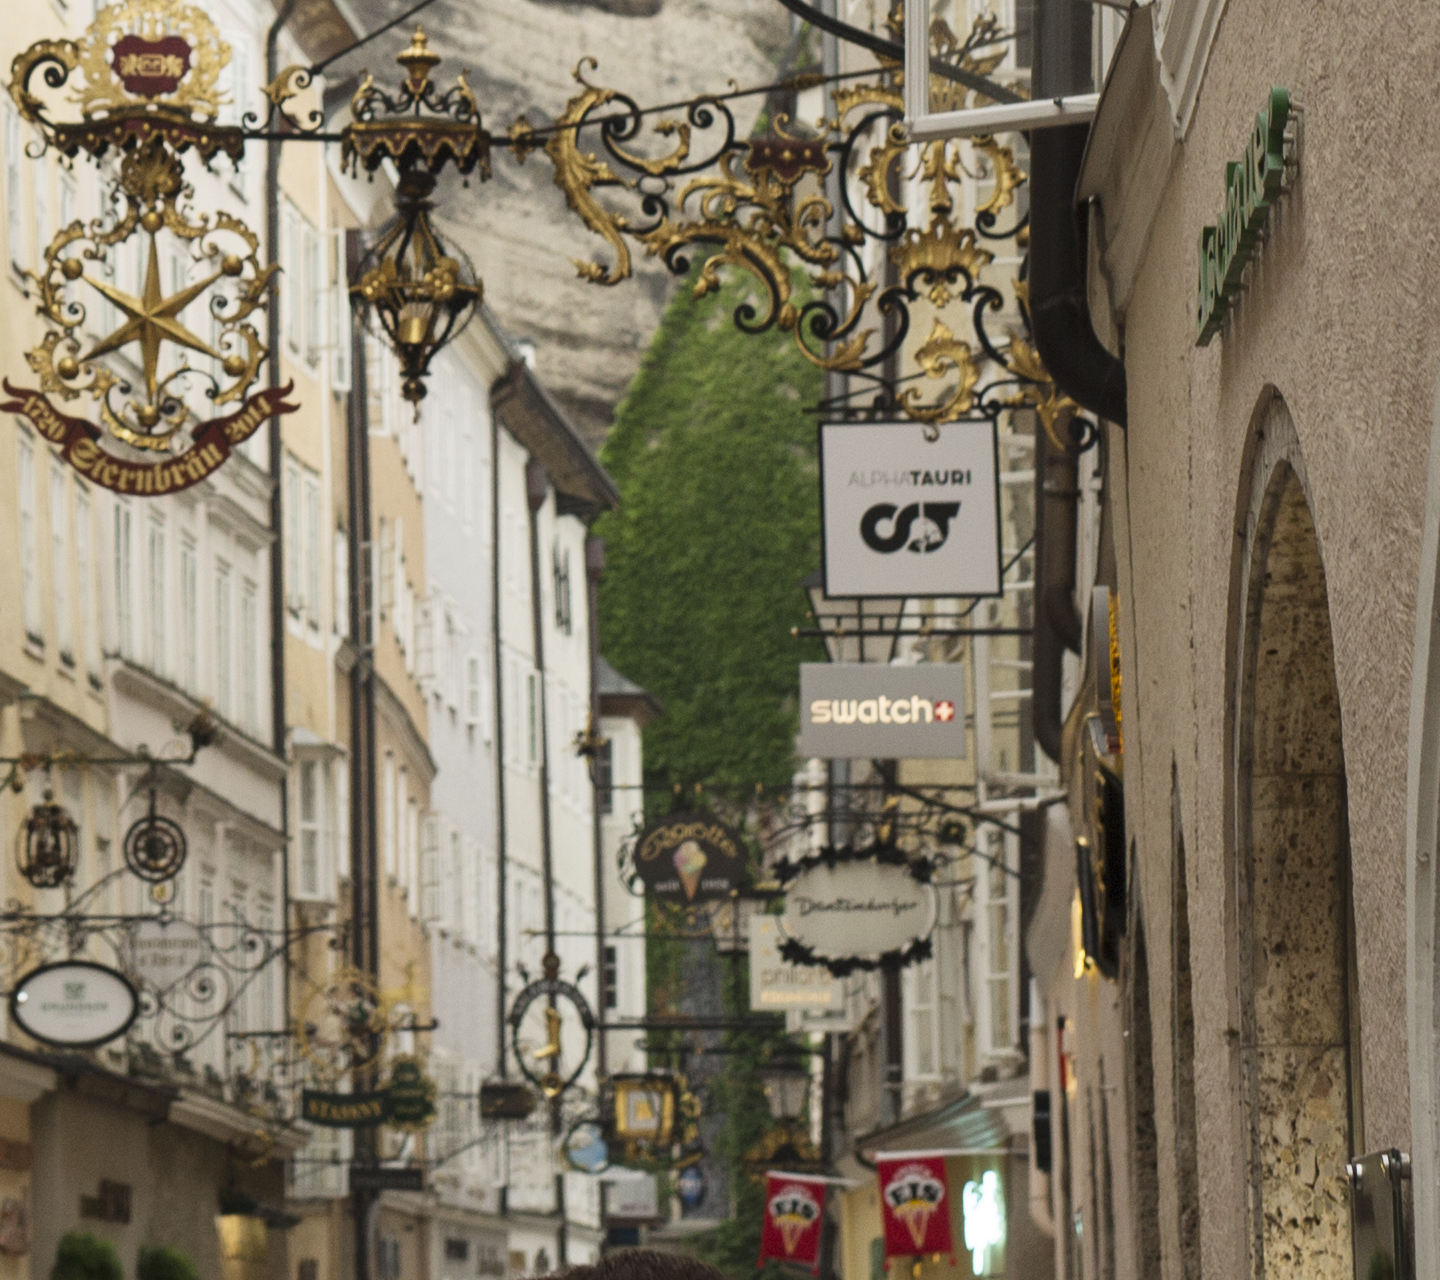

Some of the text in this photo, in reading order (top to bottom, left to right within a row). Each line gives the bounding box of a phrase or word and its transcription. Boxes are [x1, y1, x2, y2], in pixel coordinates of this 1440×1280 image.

[70, 437, 225, 493] Sternbräu
[810, 695, 934, 726] swatch
[891, 1182, 938, 1206] EIS
[775, 1200, 815, 1221] EIS
